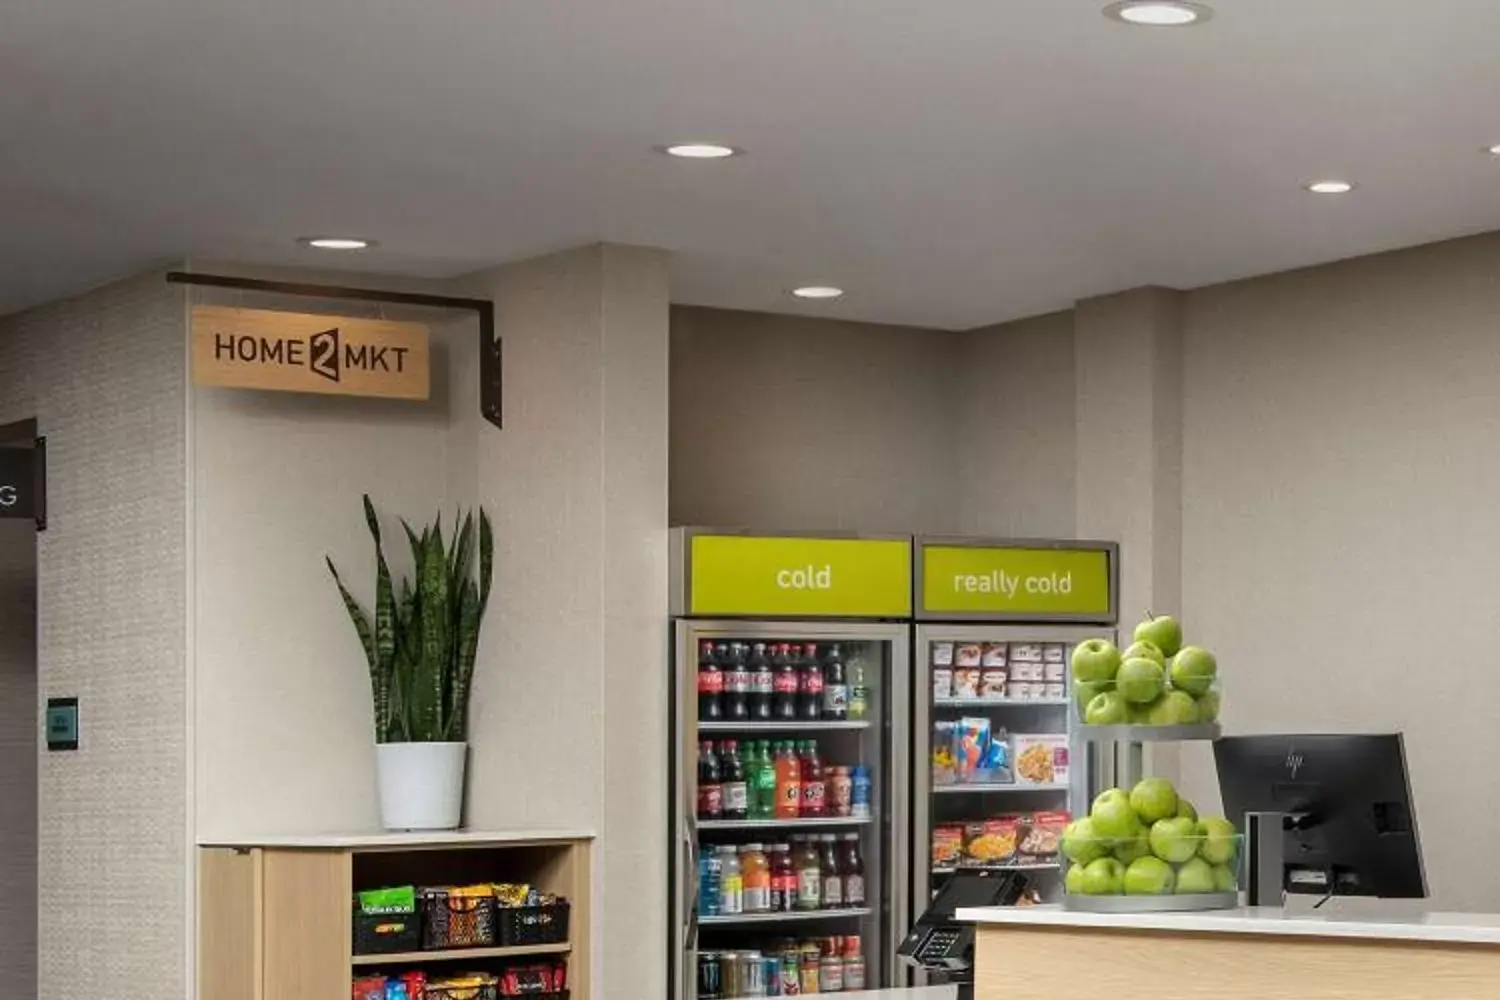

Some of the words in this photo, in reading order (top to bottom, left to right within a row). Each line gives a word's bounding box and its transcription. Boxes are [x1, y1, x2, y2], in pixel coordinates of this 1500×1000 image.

[777, 565, 831, 589] cold
[954, 571, 1018, 598] really
[1025, 572, 1072, 593] cold
